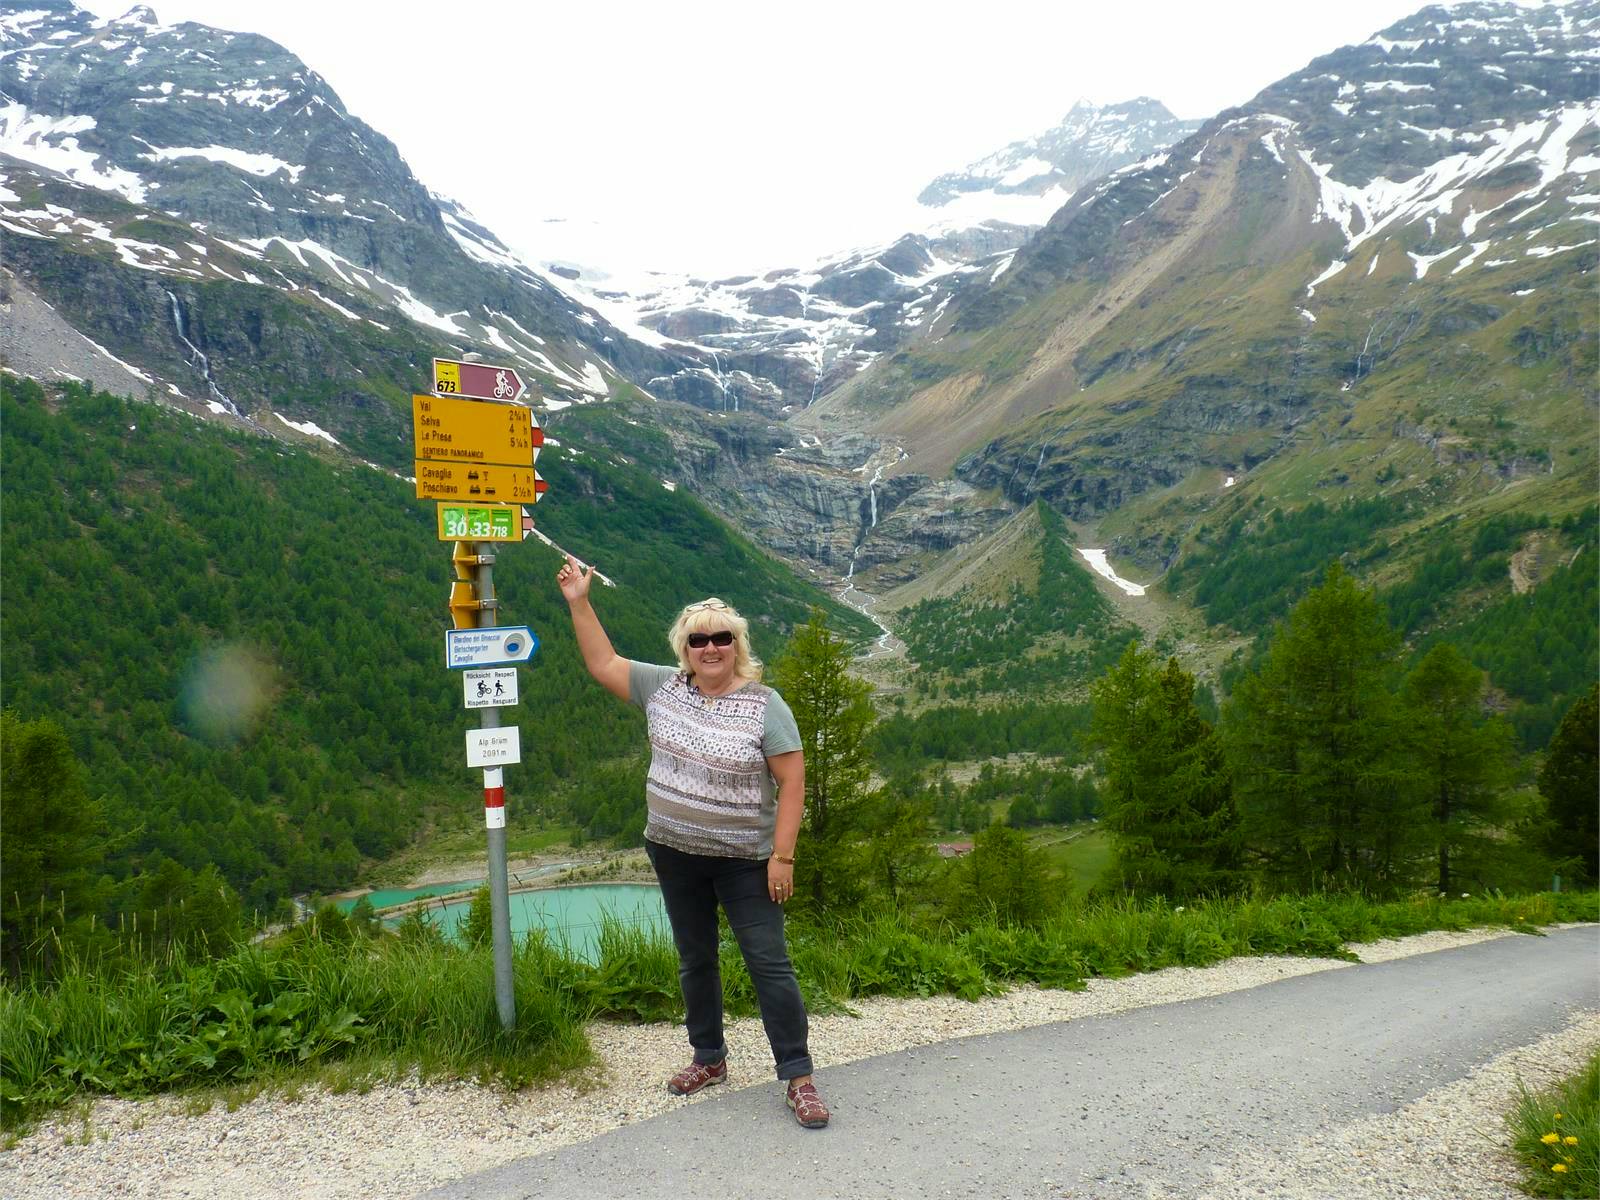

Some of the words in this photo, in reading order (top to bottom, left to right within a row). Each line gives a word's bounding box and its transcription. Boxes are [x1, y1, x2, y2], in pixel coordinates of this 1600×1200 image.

[437, 380, 455, 392] 673
[420, 401, 430, 411] Val
[421, 415, 440, 427] Selva
[510, 424, 514, 433] 4
[422, 431, 429, 440] Le
[432, 430, 452, 442] Prese
[423, 446, 448, 456] SENTIERO
[451, 449, 484, 458] PANORAMICO
[423, 467, 452, 480] Cavaglia
[513, 473, 516, 483] 1
[527, 474, 530, 483] h
[423, 482, 457, 494] Poschiavo
[527, 487, 531, 497] h
[446, 520, 467, 537] 30
[472, 522, 491, 537] 33
[492, 526, 508, 537] 718
